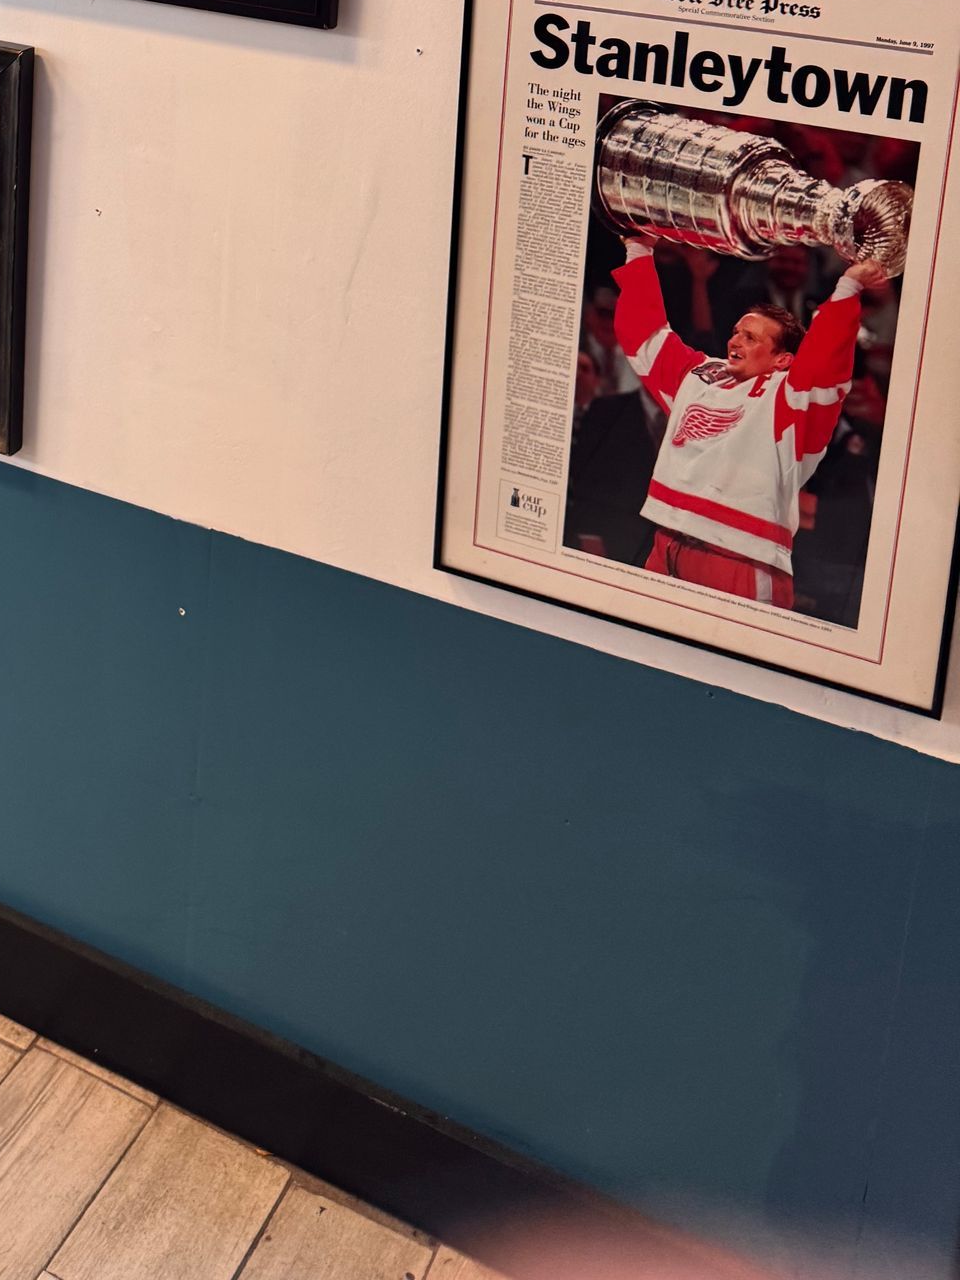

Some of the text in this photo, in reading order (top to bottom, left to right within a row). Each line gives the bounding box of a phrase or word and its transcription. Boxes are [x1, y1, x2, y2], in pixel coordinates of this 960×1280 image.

[678, 5, 775, 24] Special Commemorative Section
[876, 36, 897, 46] Monday,
[899, 39, 911, 47] June
[920, 42, 935, 50] 1997
[529, 13, 929, 124] Stanleytown
[528, 82, 581, 103] The night
[527, 98, 581, 118] the Wings
[526, 115, 580, 134] won a Cup
[524, 126, 586, 149] for the ages
[522, 154, 533, 176] T
[521, 494, 543, 506] our
[522, 502, 547, 518] cup
